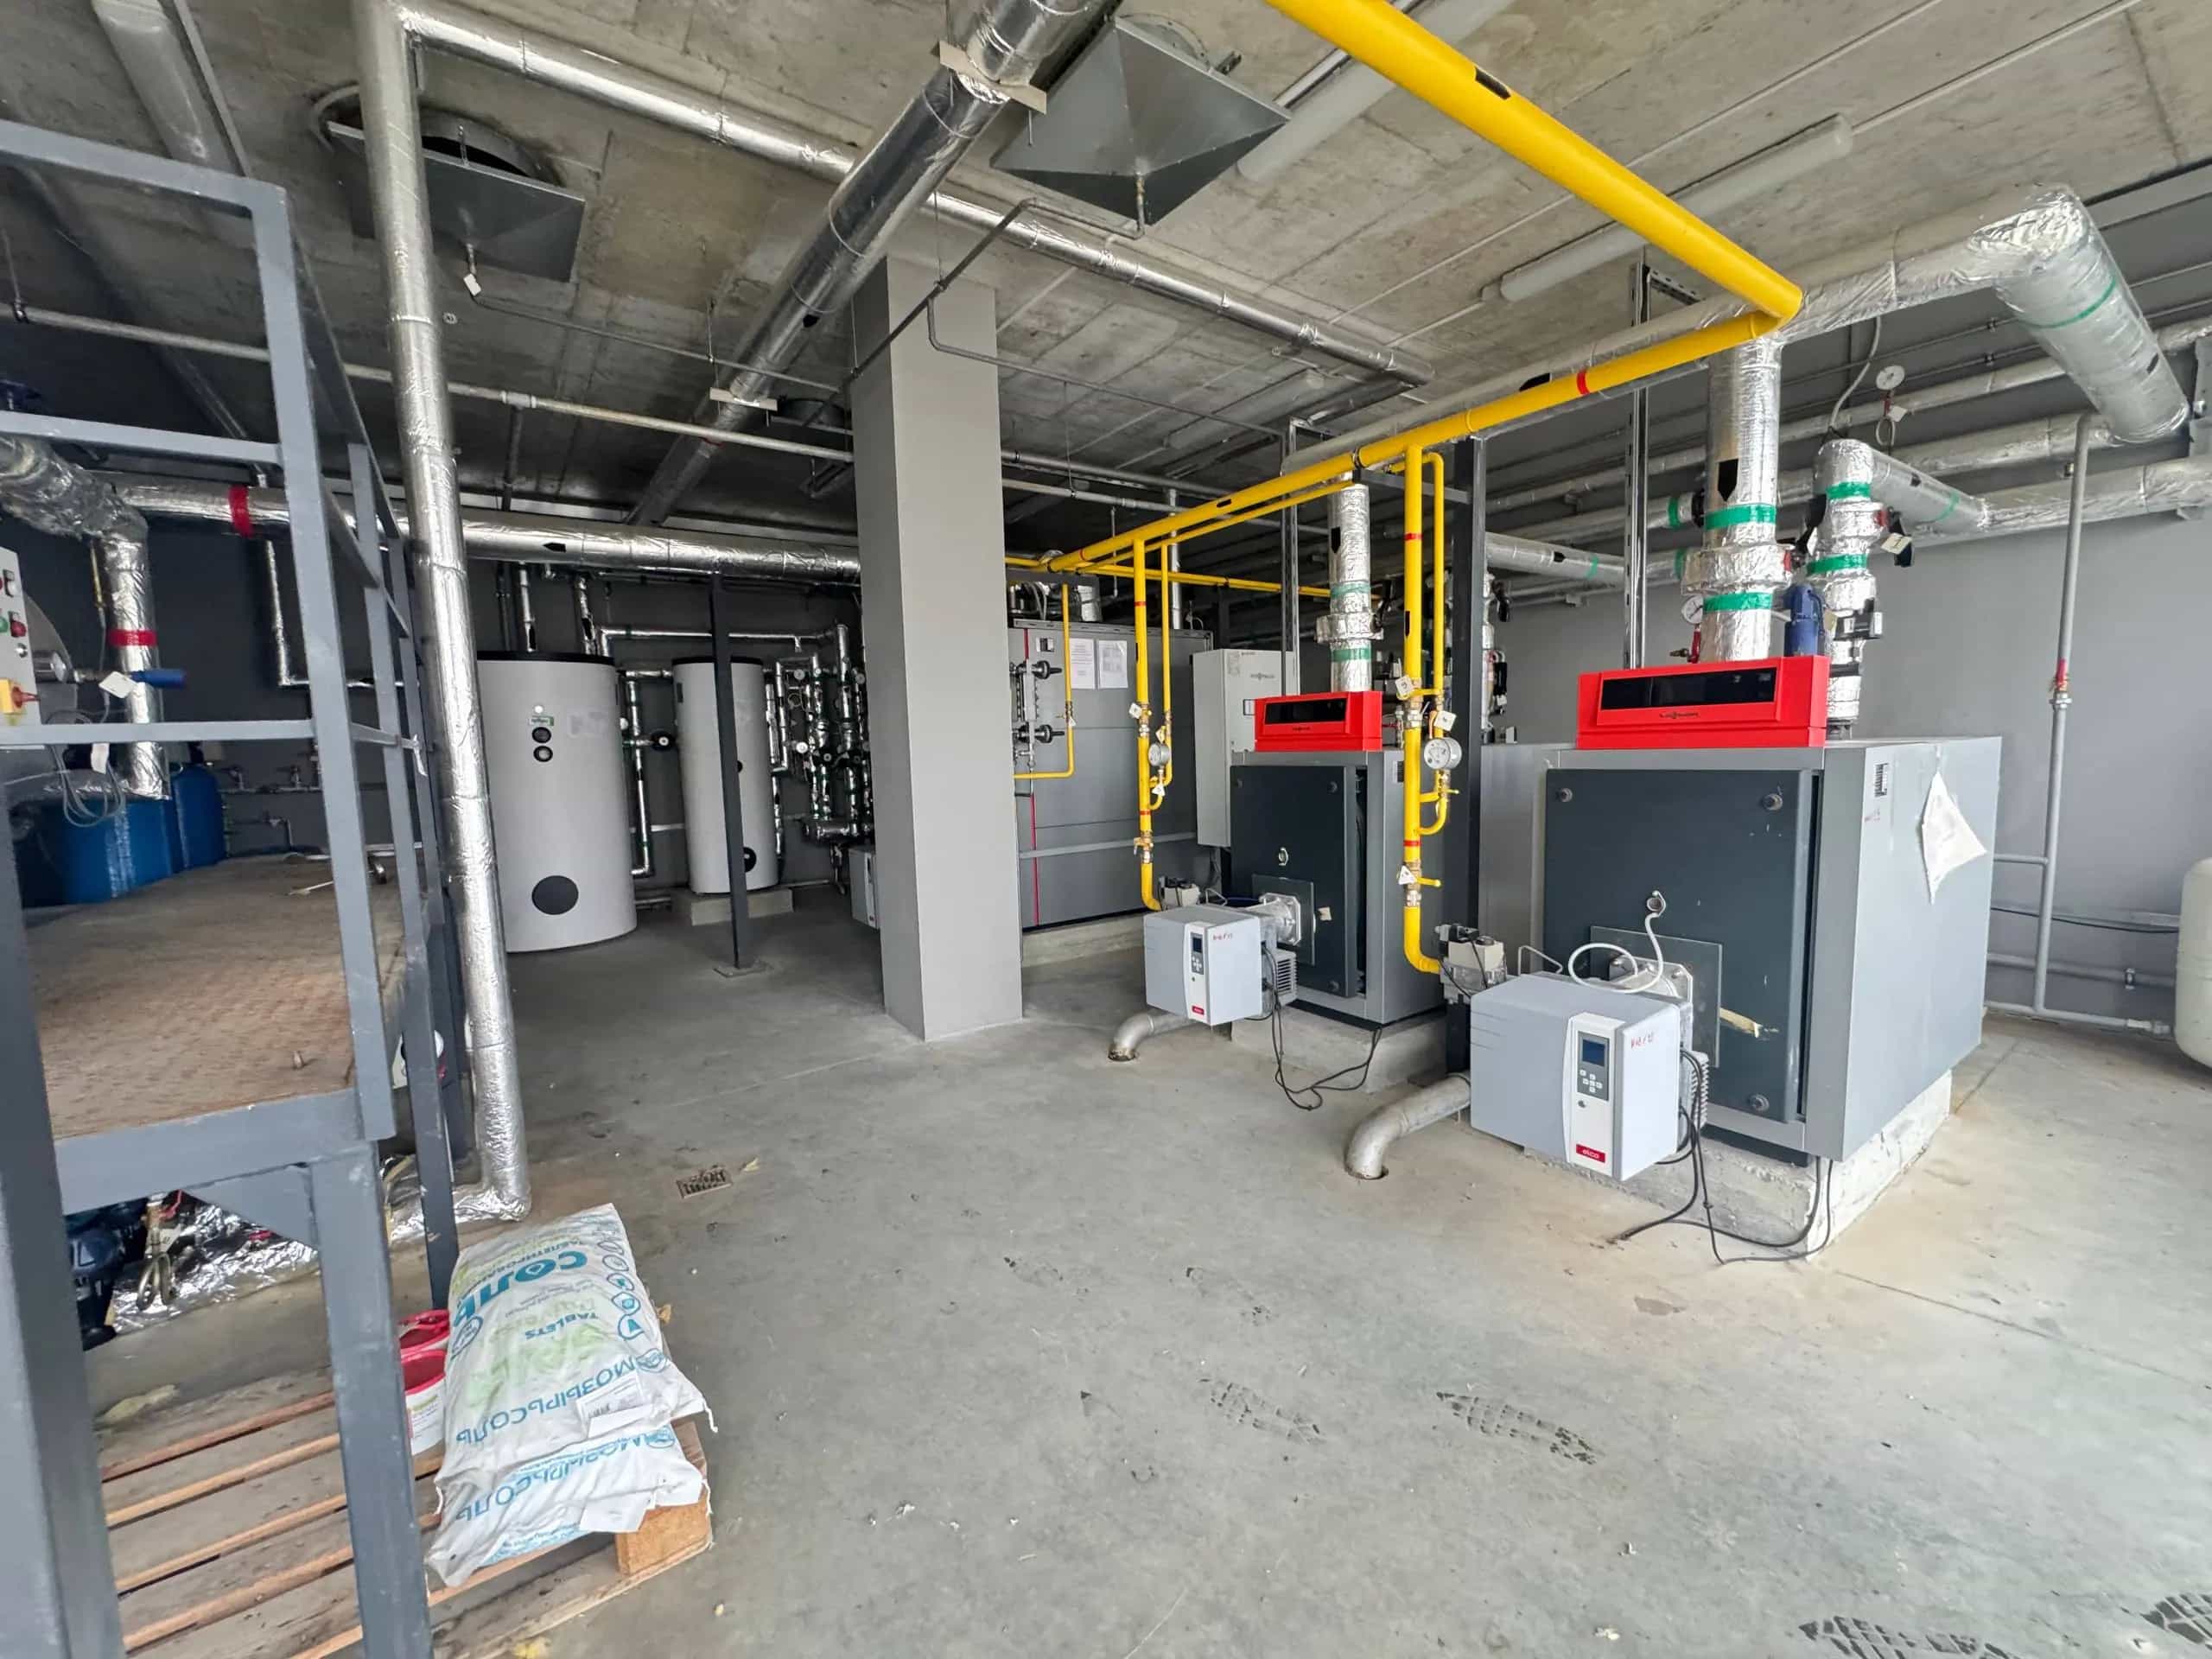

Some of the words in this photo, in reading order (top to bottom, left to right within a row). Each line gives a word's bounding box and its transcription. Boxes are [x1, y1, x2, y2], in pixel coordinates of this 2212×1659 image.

[454, 1250, 588, 1327] СОЛЬ
[524, 1313, 600, 1340] TABLETS
[456, 1356, 635, 1446] МОЗЫРЬСОЛЬ
